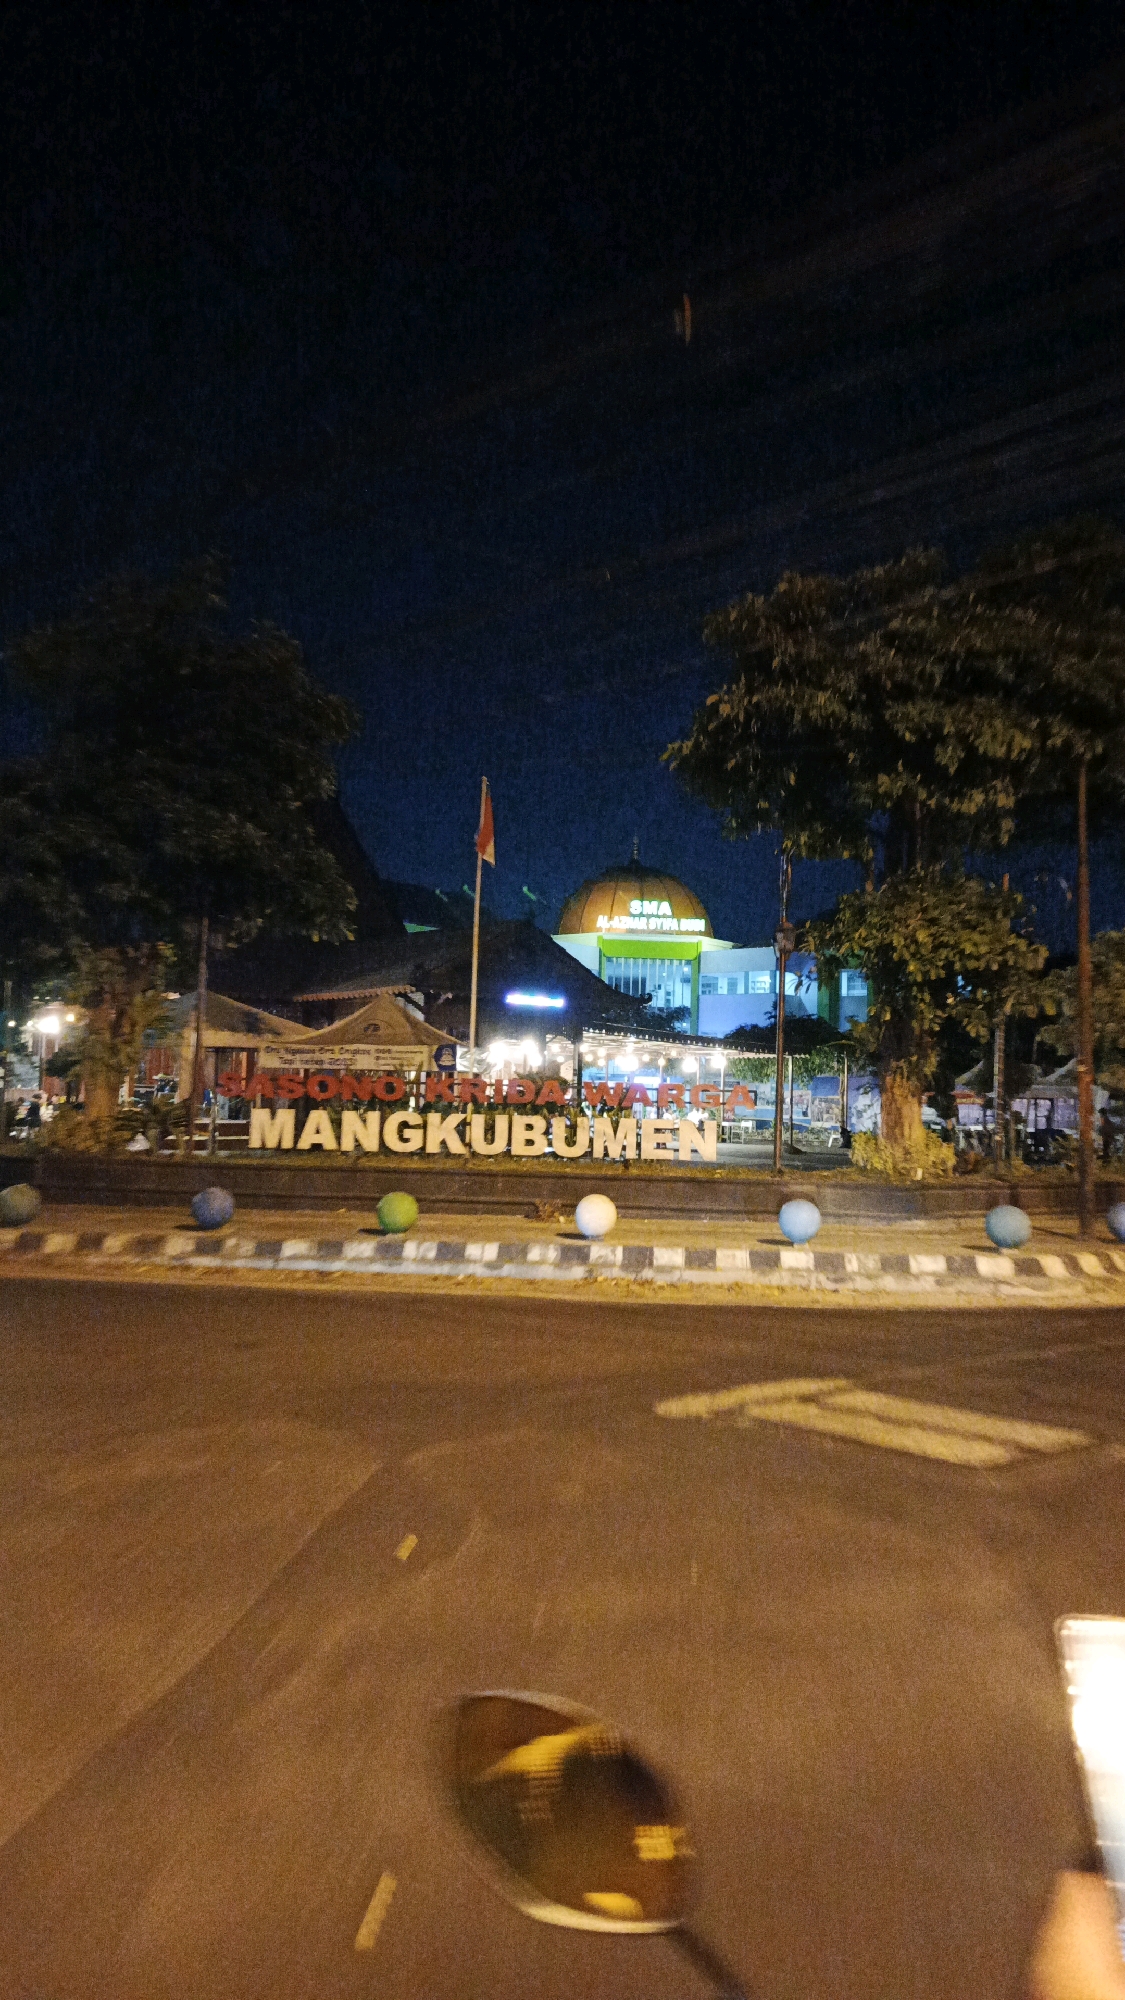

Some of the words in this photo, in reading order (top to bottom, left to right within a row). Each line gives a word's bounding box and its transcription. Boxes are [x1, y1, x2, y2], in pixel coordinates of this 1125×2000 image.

[629, 899, 672, 915] SMA
[216, 1071, 406, 1101] SASONO
[425, 1077, 567, 1106] KRIDA
[583, 1081, 756, 1110] WARGA
[248, 1107, 717, 1162] MANGKUBUMEN
